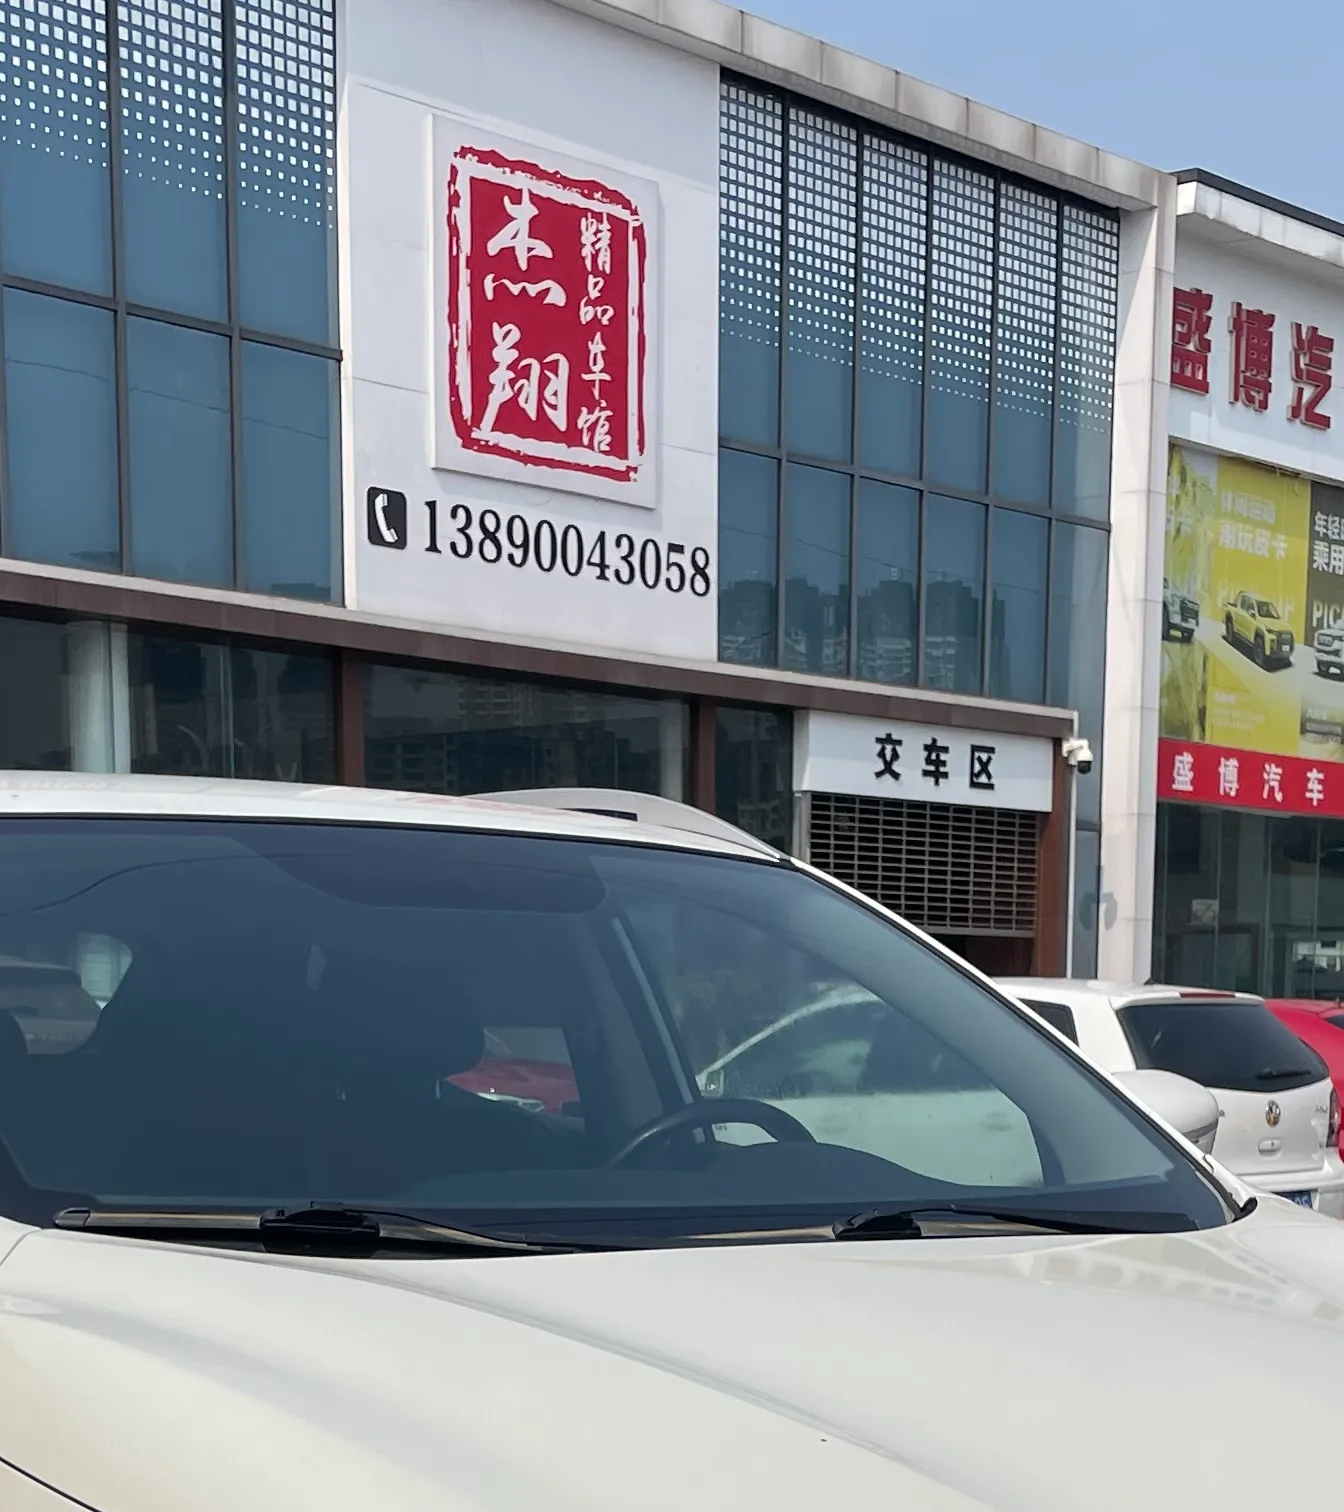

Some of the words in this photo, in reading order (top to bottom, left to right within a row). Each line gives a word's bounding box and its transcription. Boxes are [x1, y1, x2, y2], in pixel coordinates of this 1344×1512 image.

[578, 212, 614, 453] 精品车馆
[424, 499, 712, 597] 13890043058
[874, 733, 996, 790] 交车区
